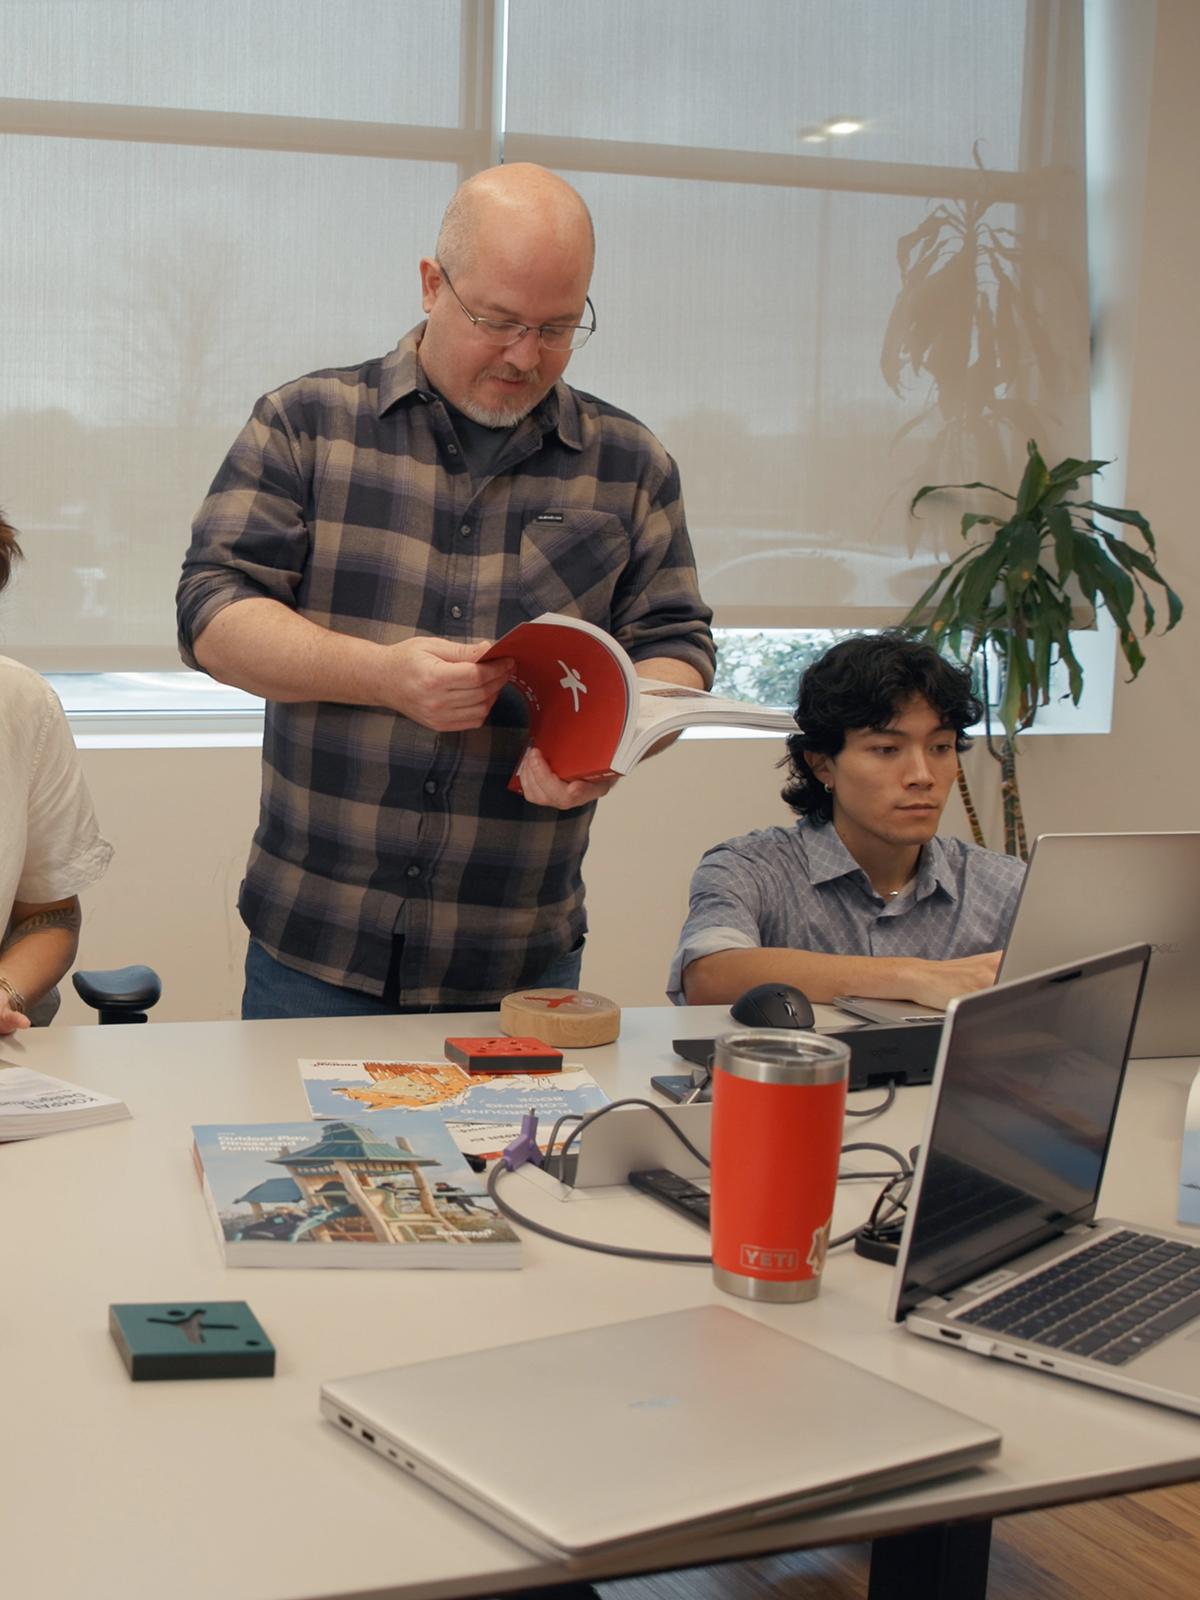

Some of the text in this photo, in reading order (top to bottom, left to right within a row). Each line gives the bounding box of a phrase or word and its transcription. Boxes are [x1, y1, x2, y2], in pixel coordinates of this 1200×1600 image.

[1150, 943, 1180, 954] DELL
[25, 1097, 98, 1110] KOMPAN
[34, 1093, 87, 1105] Design
[745, 1250, 794, 1268] YETI
